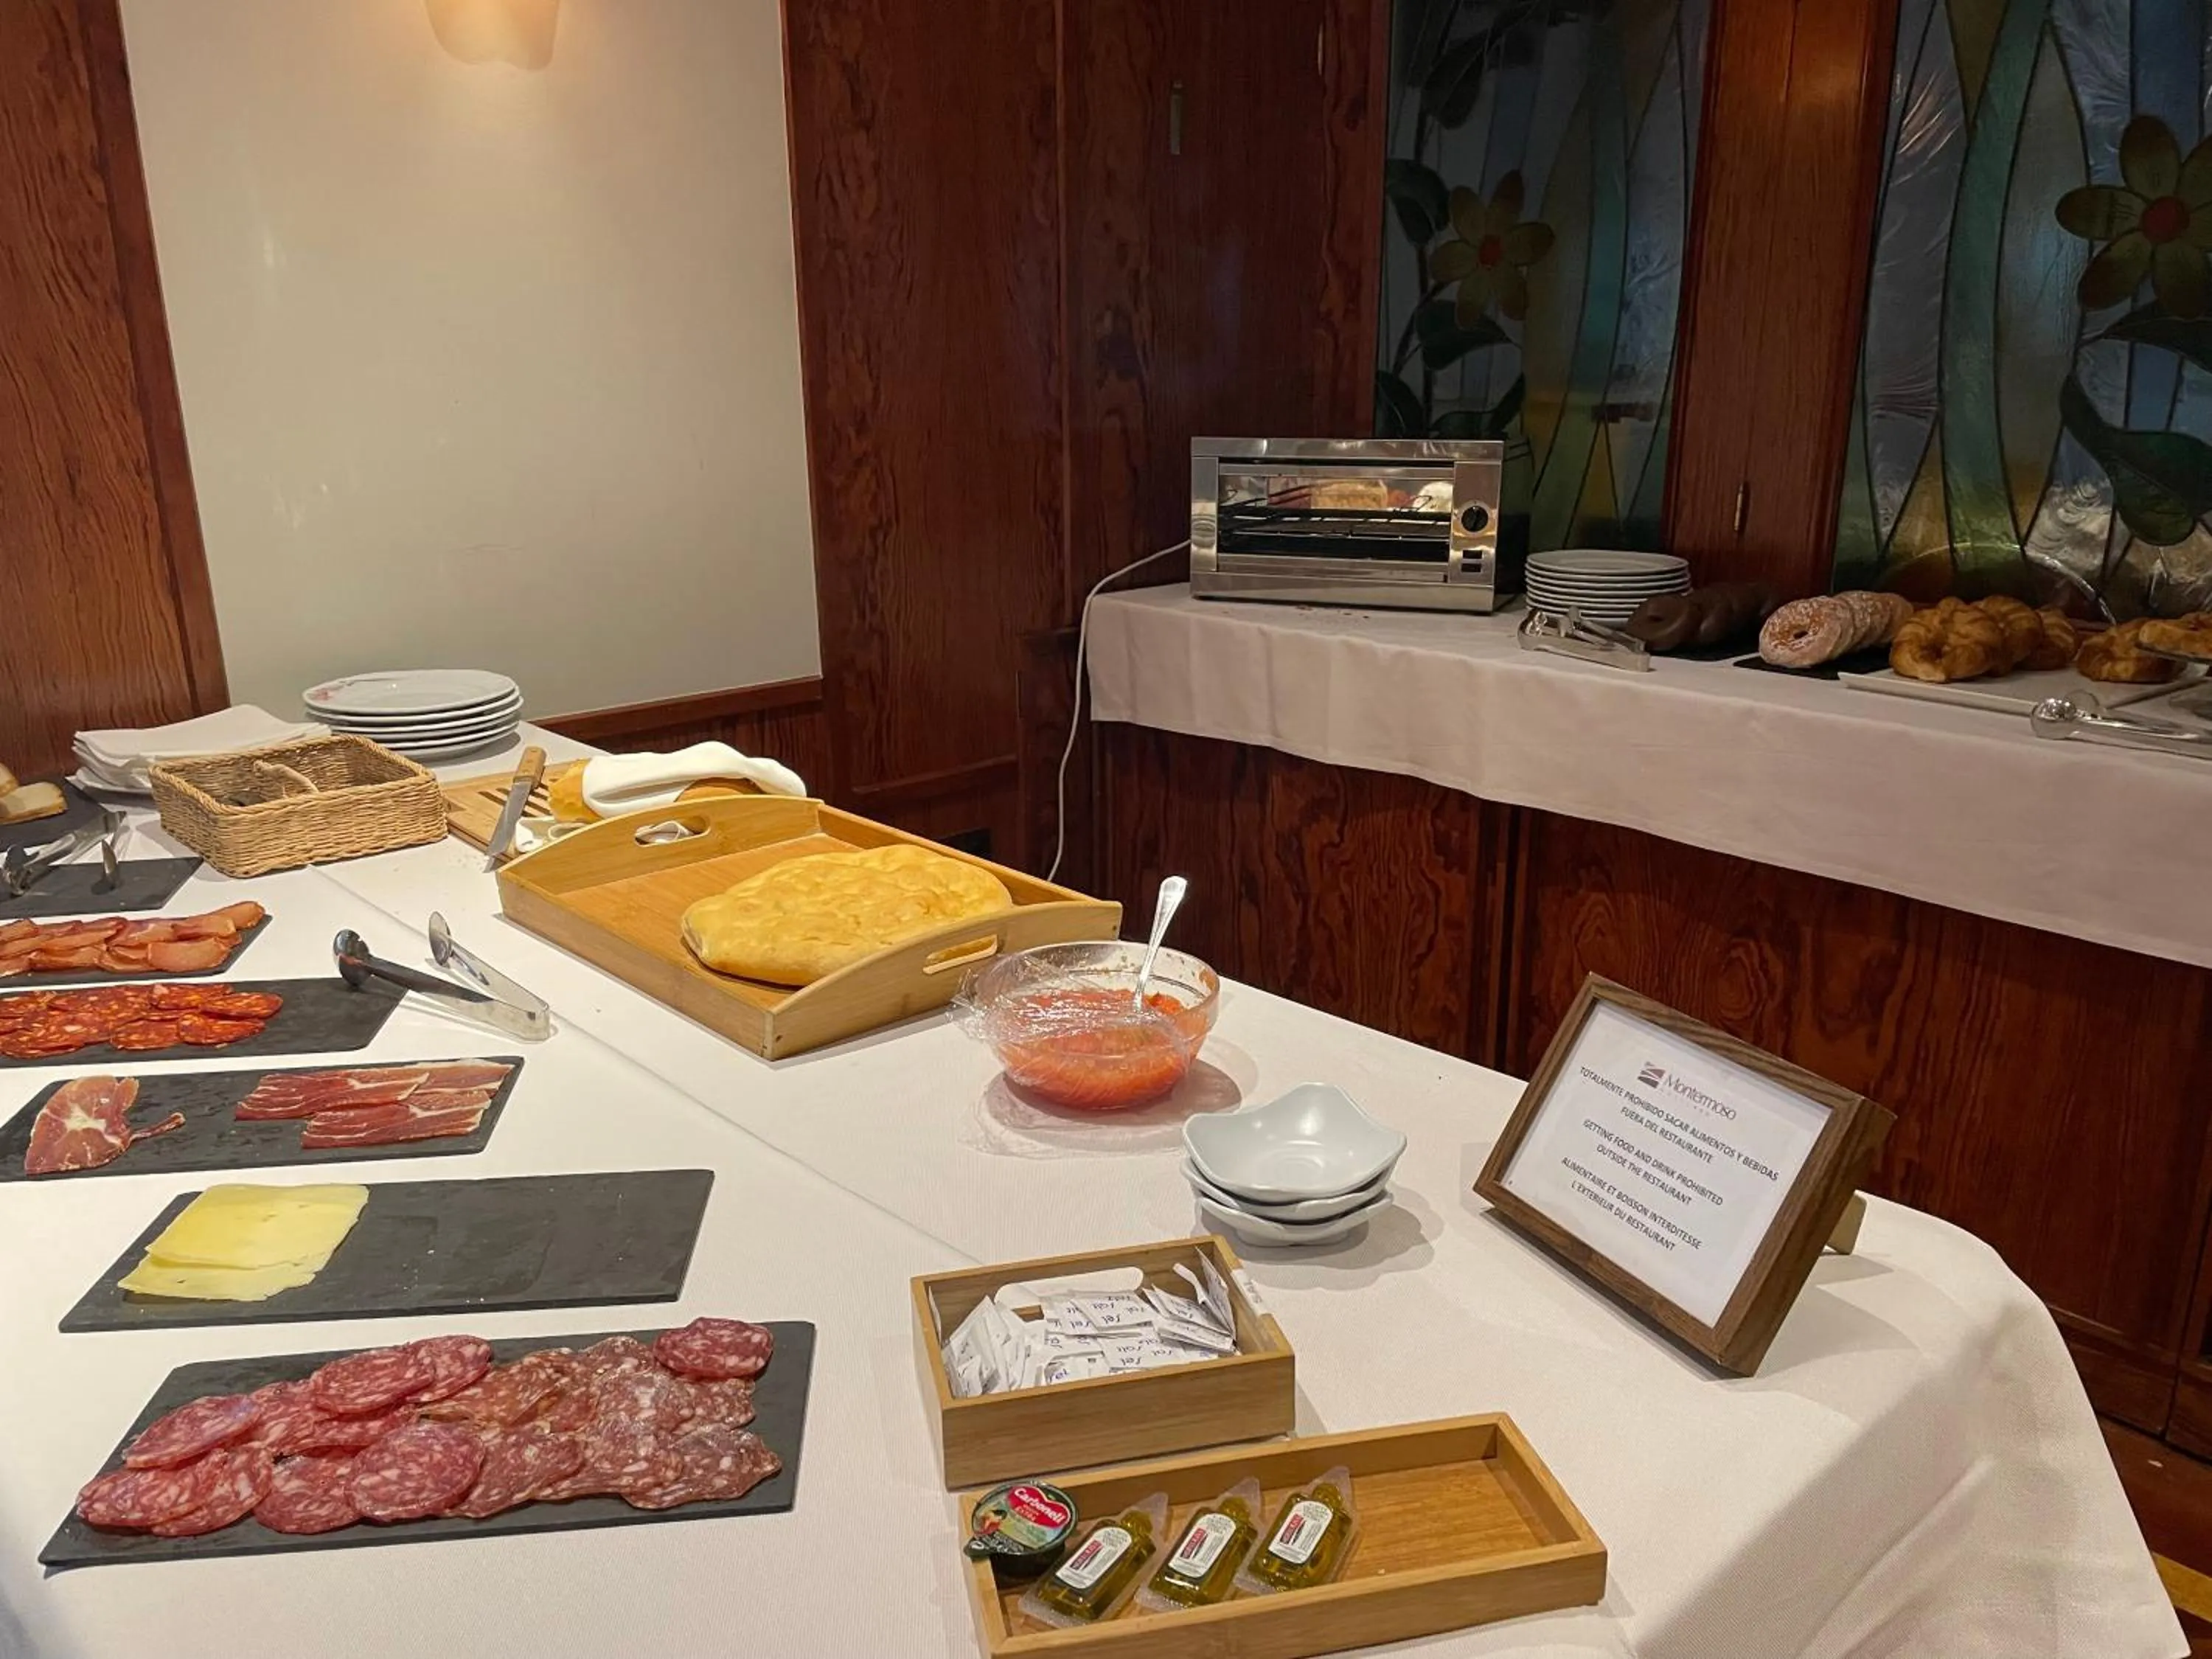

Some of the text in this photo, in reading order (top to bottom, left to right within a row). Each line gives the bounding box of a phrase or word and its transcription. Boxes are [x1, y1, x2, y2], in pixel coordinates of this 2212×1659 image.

[1580, 1067, 1624, 1096] TOTALMENTE
[1624, 1091, 1664, 1119] PROHIBIDO
[1665, 1113, 1690, 1133] SACAR
[1690, 1127, 1736, 1158] ALIMENTOS
[1736, 1152, 1744, 1162] Y
[1742, 1155, 1779, 1180] BEBIDAS
[1664, 1074, 1736, 1120] Montermoso
[1583, 1119, 1723, 1206] GETTING FOOD AND DRINK PROHIBITED
[1621, 1106, 1714, 1164] FUERA DEL RESTAURANTE
[1562, 1157, 1702, 1249] ALIMENTAIRE ET BOISSON INTERDITESSE
[1596, 1144, 1692, 1205] OUTSIDE THE RESTAURANT
[1614, 1207, 1627, 1221] DU
[1625, 1214, 1675, 1251] RESTAURANT
[1015, 1488, 1066, 1524] Carbonell
